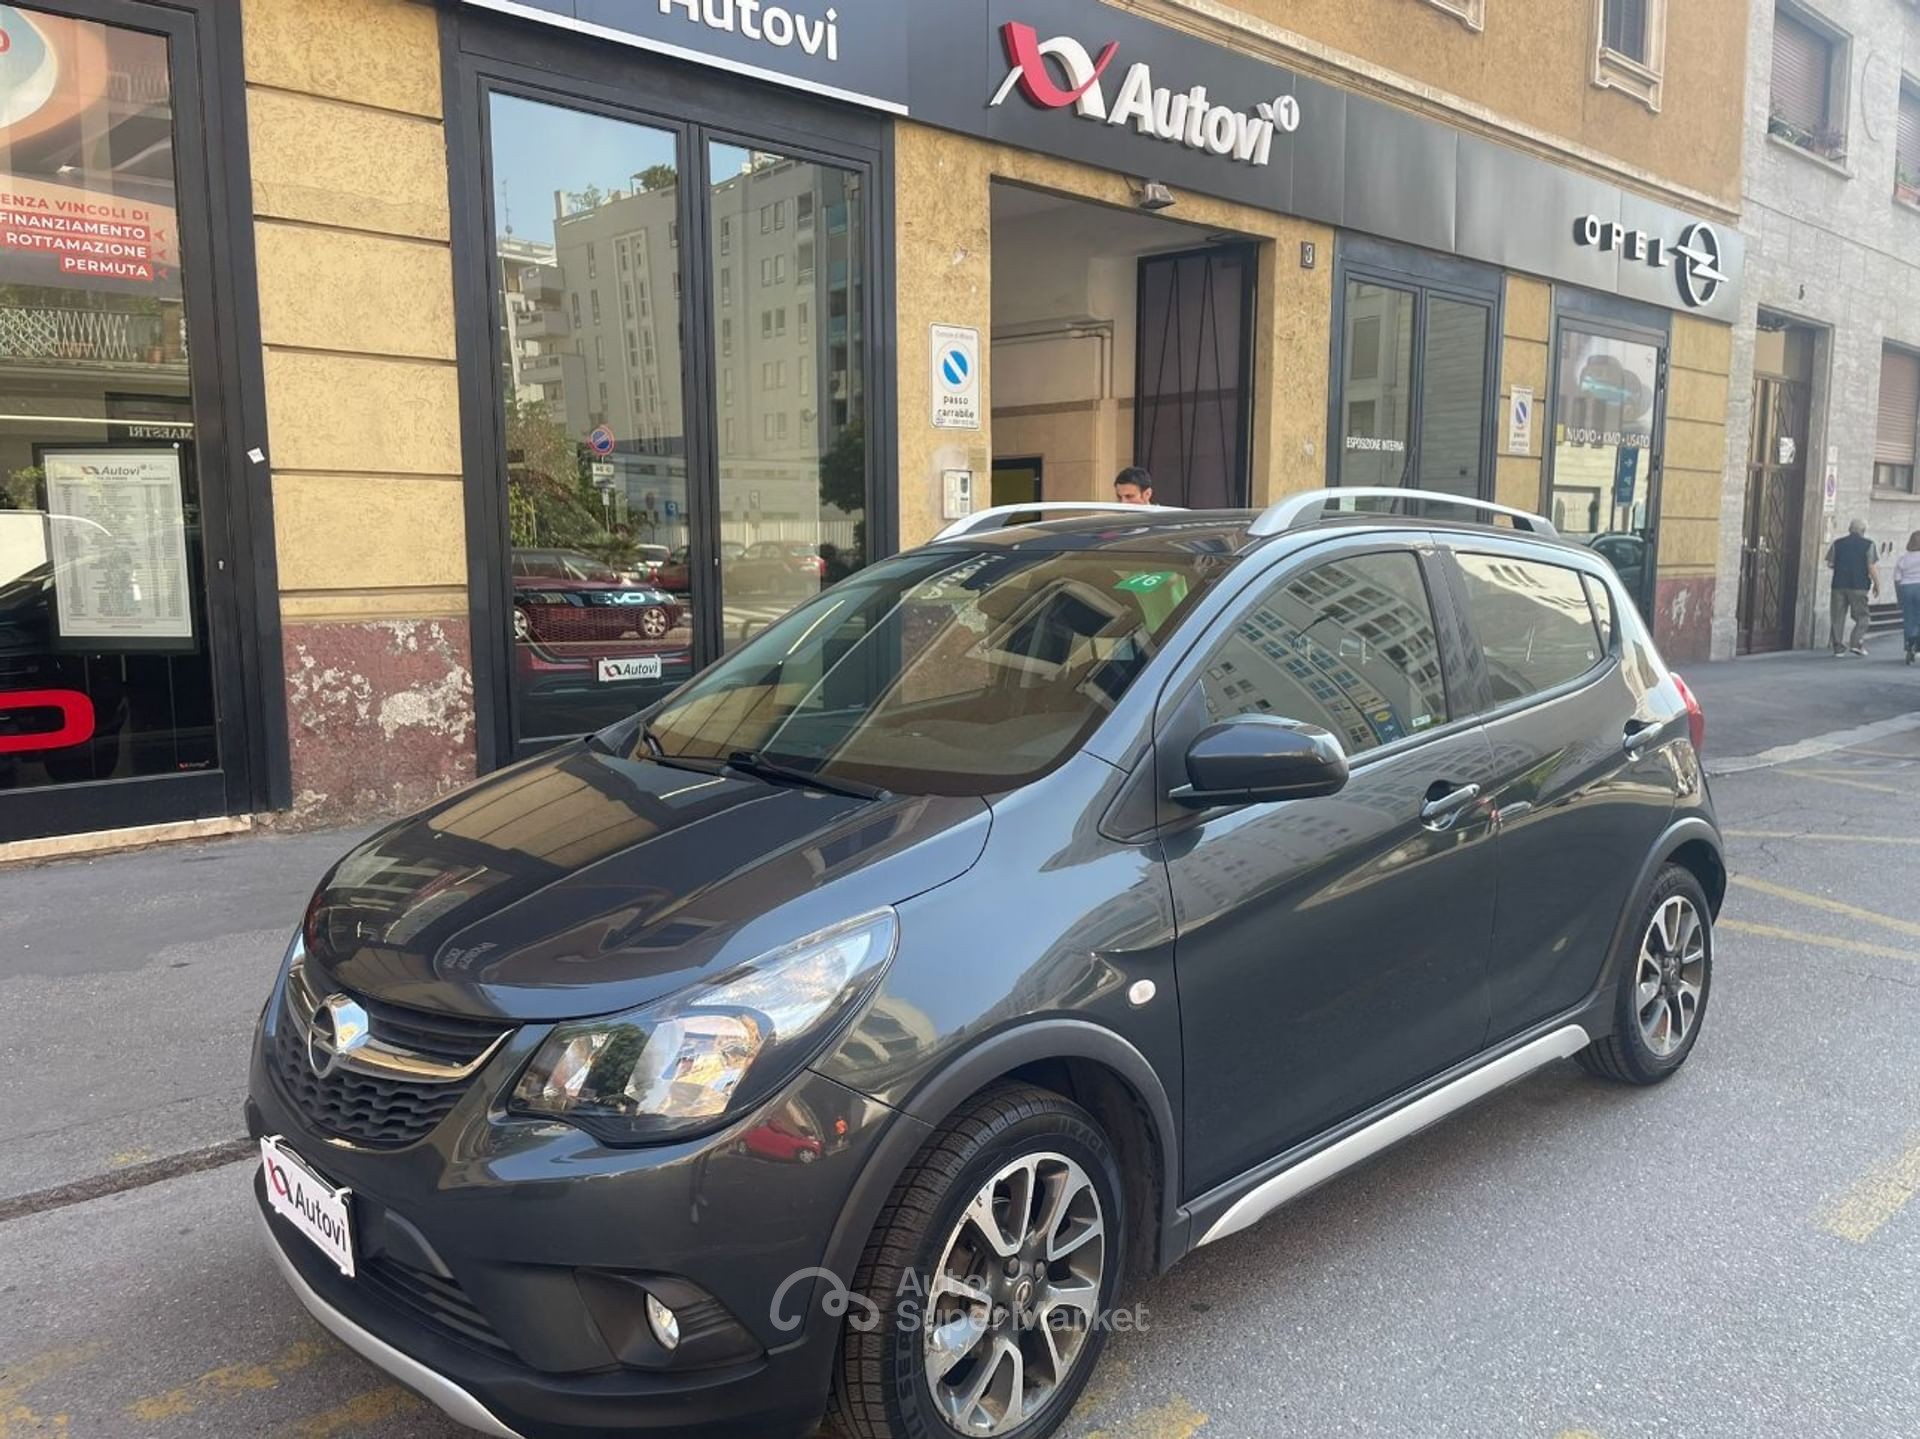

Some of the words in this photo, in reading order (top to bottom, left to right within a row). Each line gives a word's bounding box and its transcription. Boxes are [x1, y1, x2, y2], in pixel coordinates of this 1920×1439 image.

[55, 200, 126, 219] VINCOLI
[132, 209, 150, 222] DI
[0, 212, 146, 240] FINANZIAMENTO
[6, 232, 147, 259] ROTTAMAZIONE
[1582, 214, 1669, 267] OPEL
[64, 257, 149, 277] PERMUTA
[943, 395, 969, 405] passo
[937, 408, 975, 418] carrabile
[1567, 427, 1597, 442] NUOVO
[101, 465, 140, 476] Autovi
[622, 661, 658, 676] Autovi
[295, 1181, 347, 1252] Autovi
